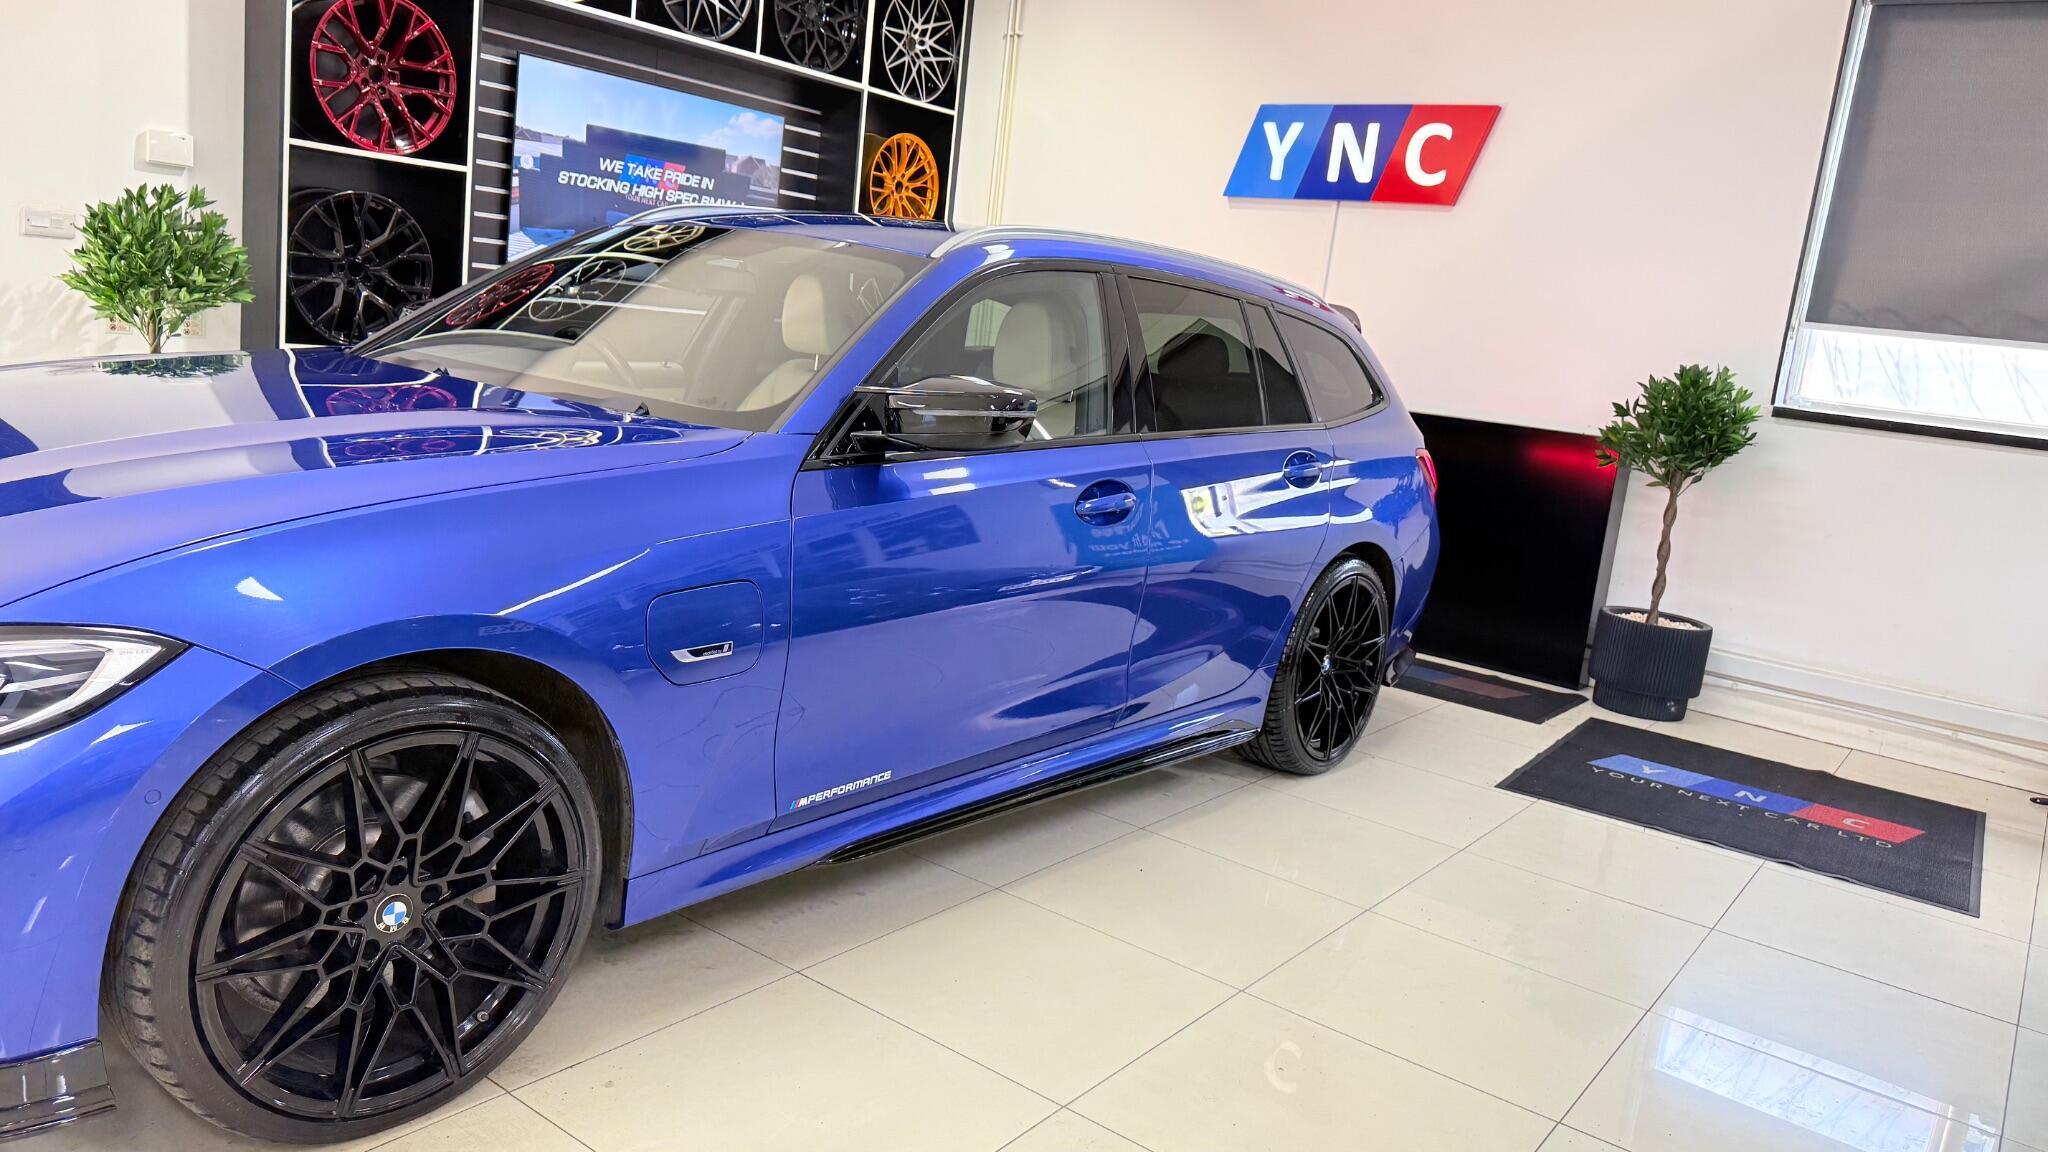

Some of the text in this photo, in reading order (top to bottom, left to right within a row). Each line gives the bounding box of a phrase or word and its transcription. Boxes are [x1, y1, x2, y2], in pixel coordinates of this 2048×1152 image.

[599, 157, 625, 174] WE
[627, 163, 663, 181] TAKE
[664, 169, 701, 188] PRIDE
[701, 176, 715, 190] IN
[1263, 121, 1453, 187] YNC
[558, 170, 630, 194] STOCKING
[631, 183, 665, 201] HIGH
[665, 189, 699, 205] SPEC
[1592, 767, 1893, 848] YOUR NEXT CAR LTD
